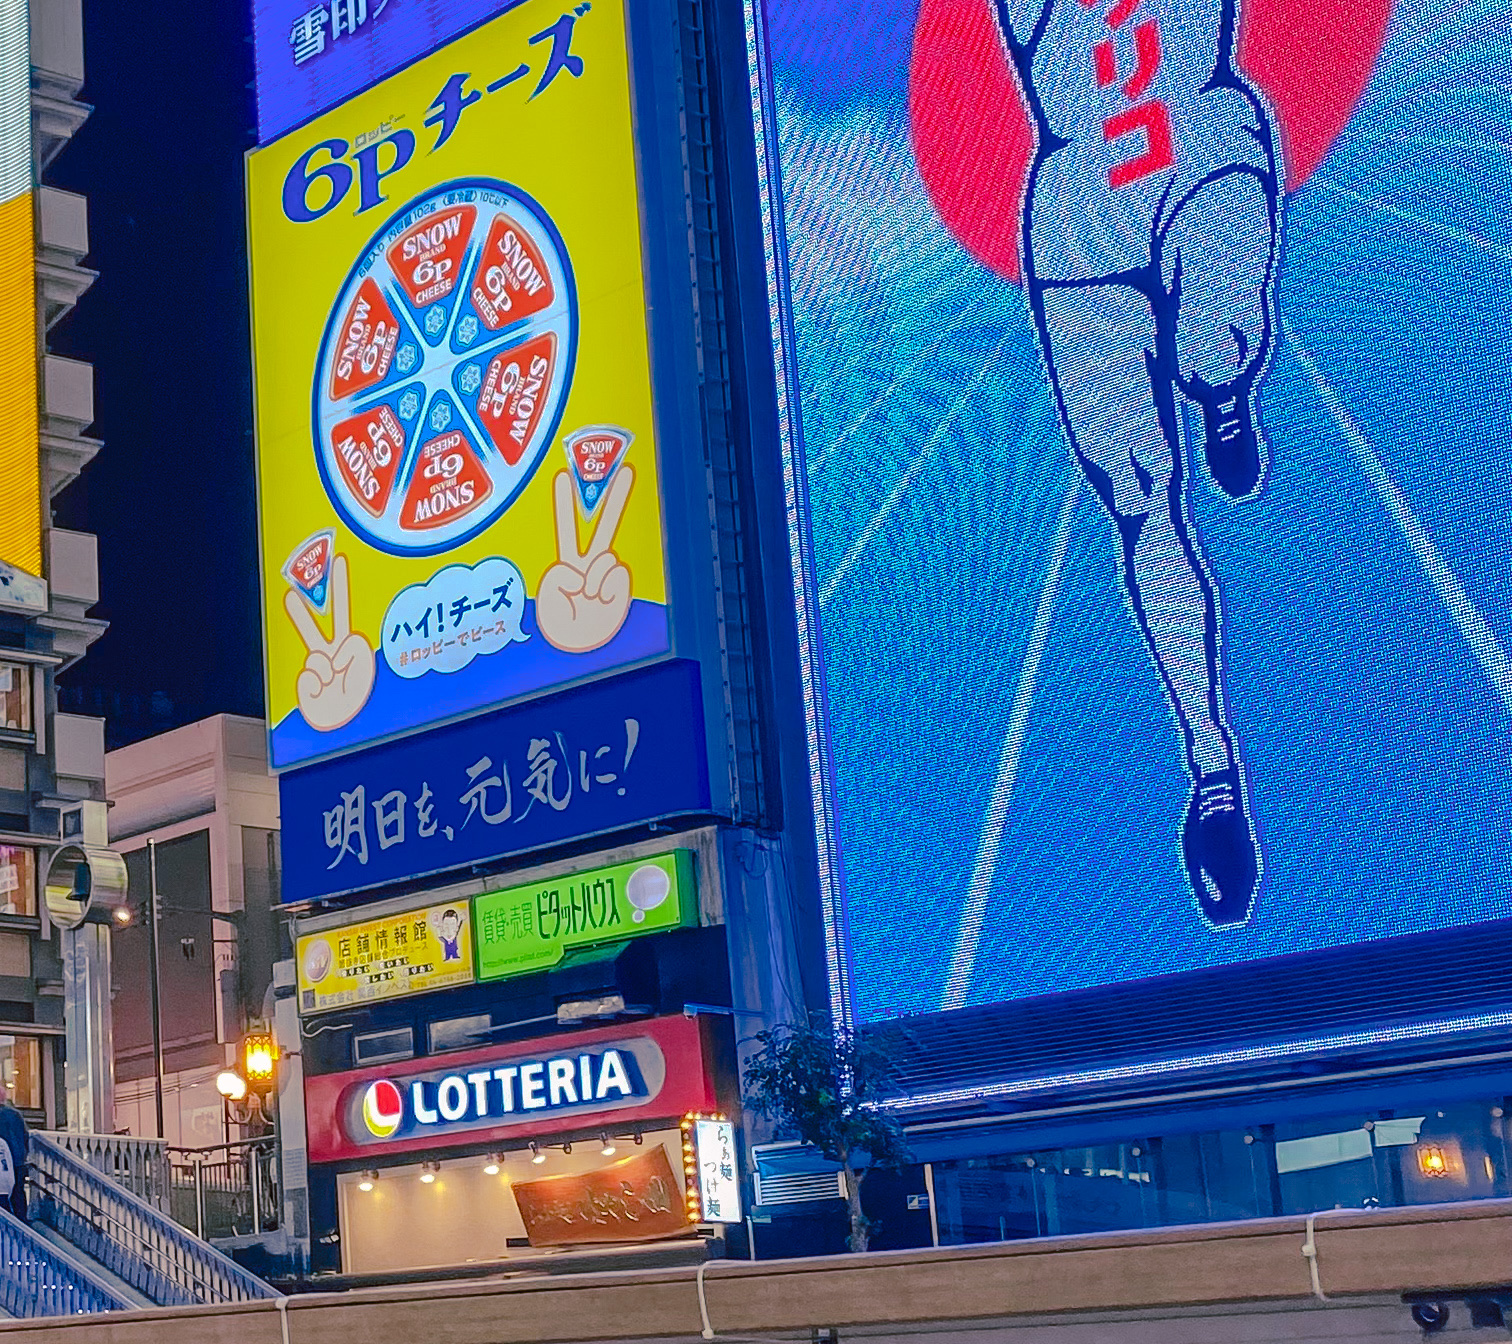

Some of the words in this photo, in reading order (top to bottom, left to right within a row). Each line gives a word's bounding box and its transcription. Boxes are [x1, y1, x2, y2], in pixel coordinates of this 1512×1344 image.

[402, 213, 462, 261] SNOW
[498, 230, 546, 298] SNOW
[415, 279, 452, 304] CHEESE
[473, 287, 500, 326] CHEESE
[338, 296, 373, 382] SNOW
[377, 326, 398, 377] CHEESE
[479, 359, 501, 412] CHEESE
[509, 355, 548, 447] SNOW
[379, 407, 402, 447] CHEESE
[424, 433, 461, 456] CHEESE
[581, 440, 615, 454] SNOW
[338, 435, 381, 501] SNOW
[413, 480, 475, 523] SNOW
[296, 543, 323, 572] SNOW
[535, 877, 622, 940] ピタットハウス
[412, 1048, 633, 1125] LOTTERIA
[703, 1161, 721, 1217] つけ麺
